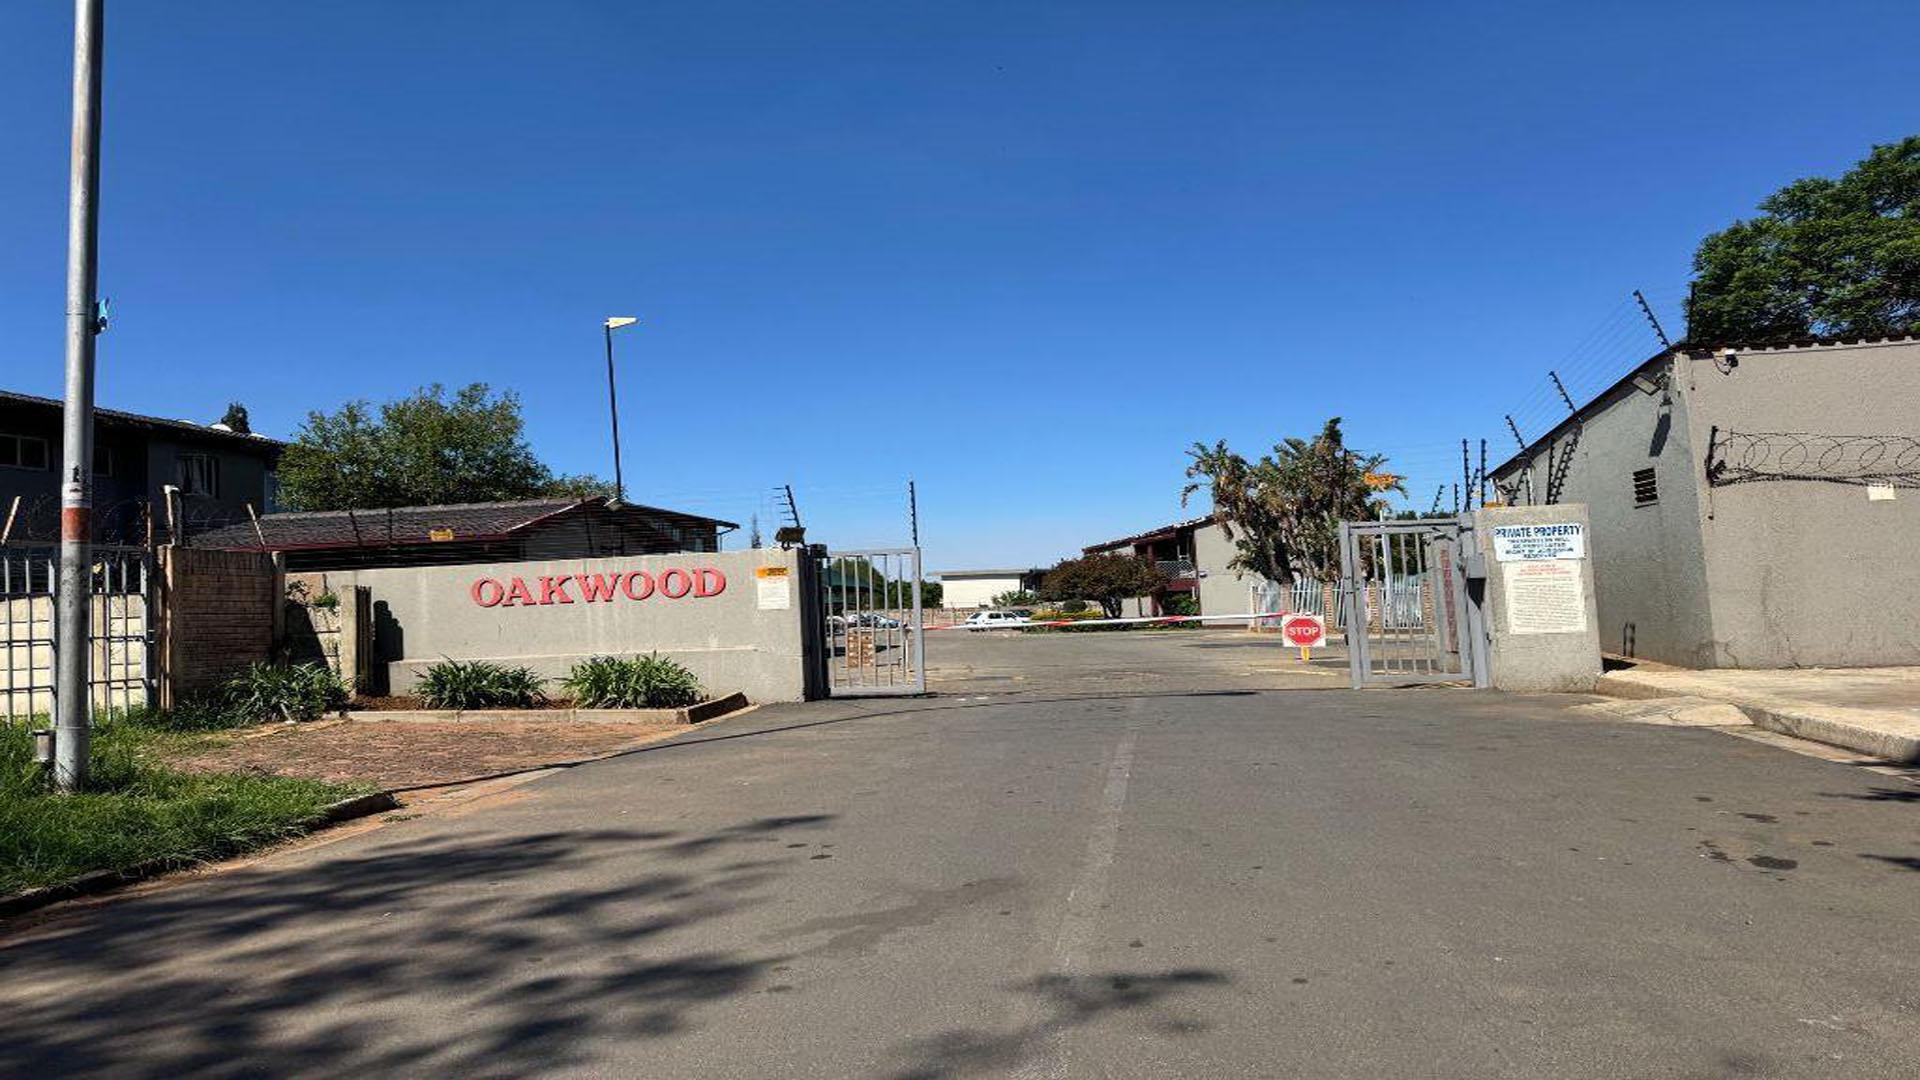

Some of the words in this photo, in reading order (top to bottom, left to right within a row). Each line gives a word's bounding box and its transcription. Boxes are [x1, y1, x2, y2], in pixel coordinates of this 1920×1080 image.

[1495, 527, 1532, 538] PRIVATE
[1533, 525, 1581, 537] PROPERTY
[471, 567, 727, 608] OAKWOOD
[1289, 626, 1319, 636] STOP
